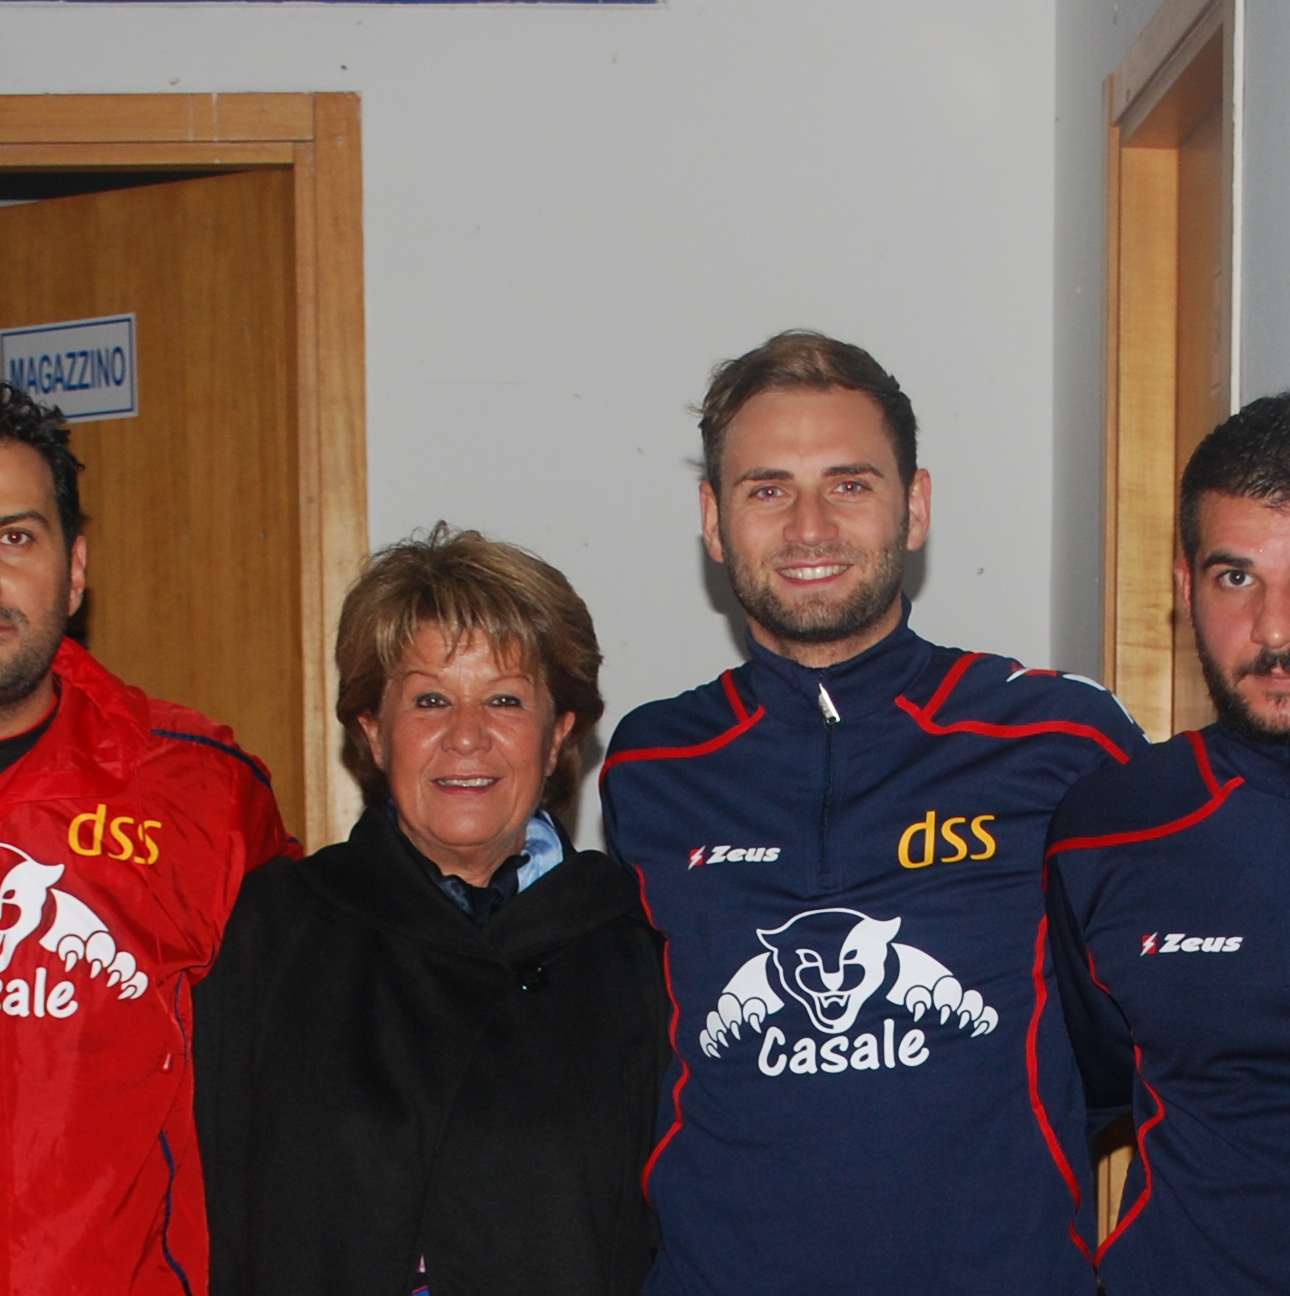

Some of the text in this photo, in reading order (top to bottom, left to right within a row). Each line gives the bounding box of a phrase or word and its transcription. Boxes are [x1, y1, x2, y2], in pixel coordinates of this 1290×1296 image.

[10, 346, 125, 395] MAGAZZINO
[67, 804, 162, 866] dss
[705, 845, 781, 865] Zeus
[898, 810, 997, 869] dss
[1158, 933, 1244, 953] Zeus
[758, 1018, 930, 1077] Casale
